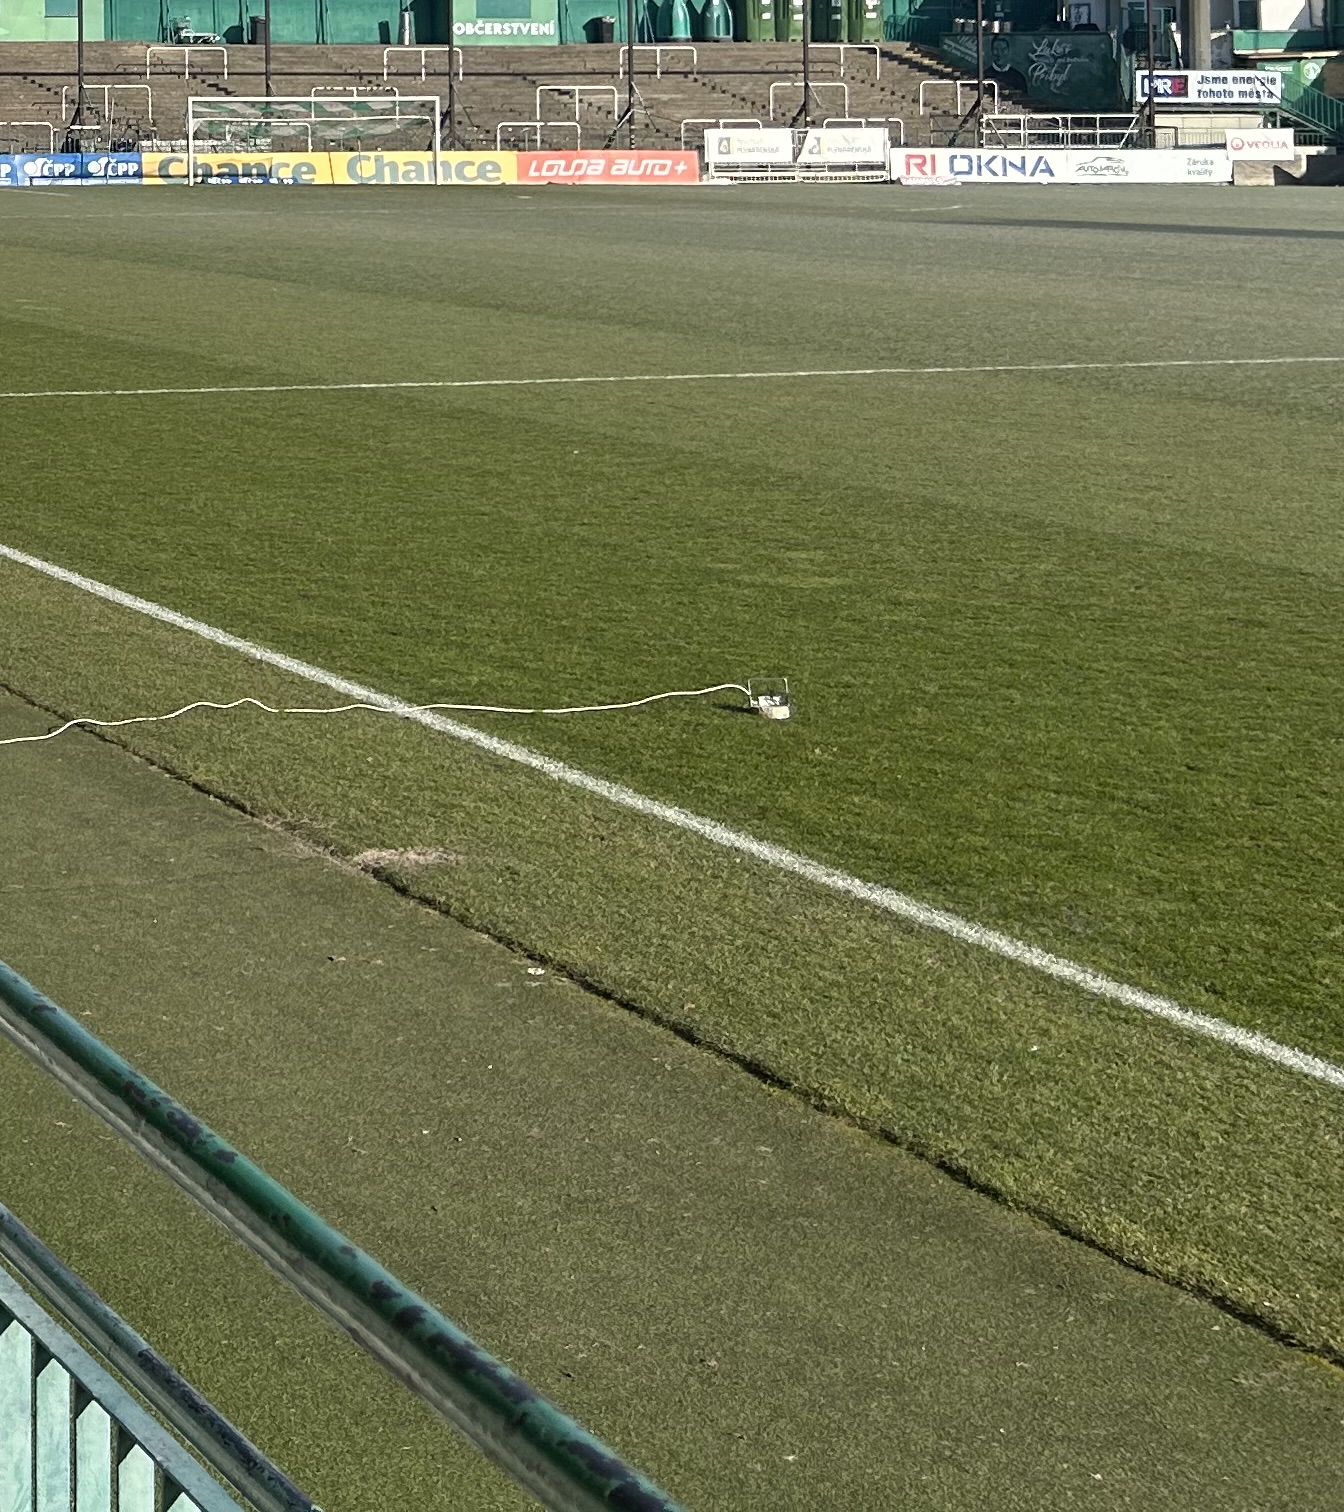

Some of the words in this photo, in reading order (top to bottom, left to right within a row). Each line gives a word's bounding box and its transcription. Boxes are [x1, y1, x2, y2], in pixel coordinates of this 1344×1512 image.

[452, 18, 555, 37] OBČERSTVENÍ
[1197, 74, 1228, 86] Jsme
[1197, 88, 1235, 99] tohoto
[42, 160, 75, 177] ČPP
[108, 158, 139, 176] ČPP
[158, 155, 317, 183] Chance
[346, 154, 502, 184] Chance
[905, 154, 936, 176] RI
[948, 154, 1055, 178] OKNA
